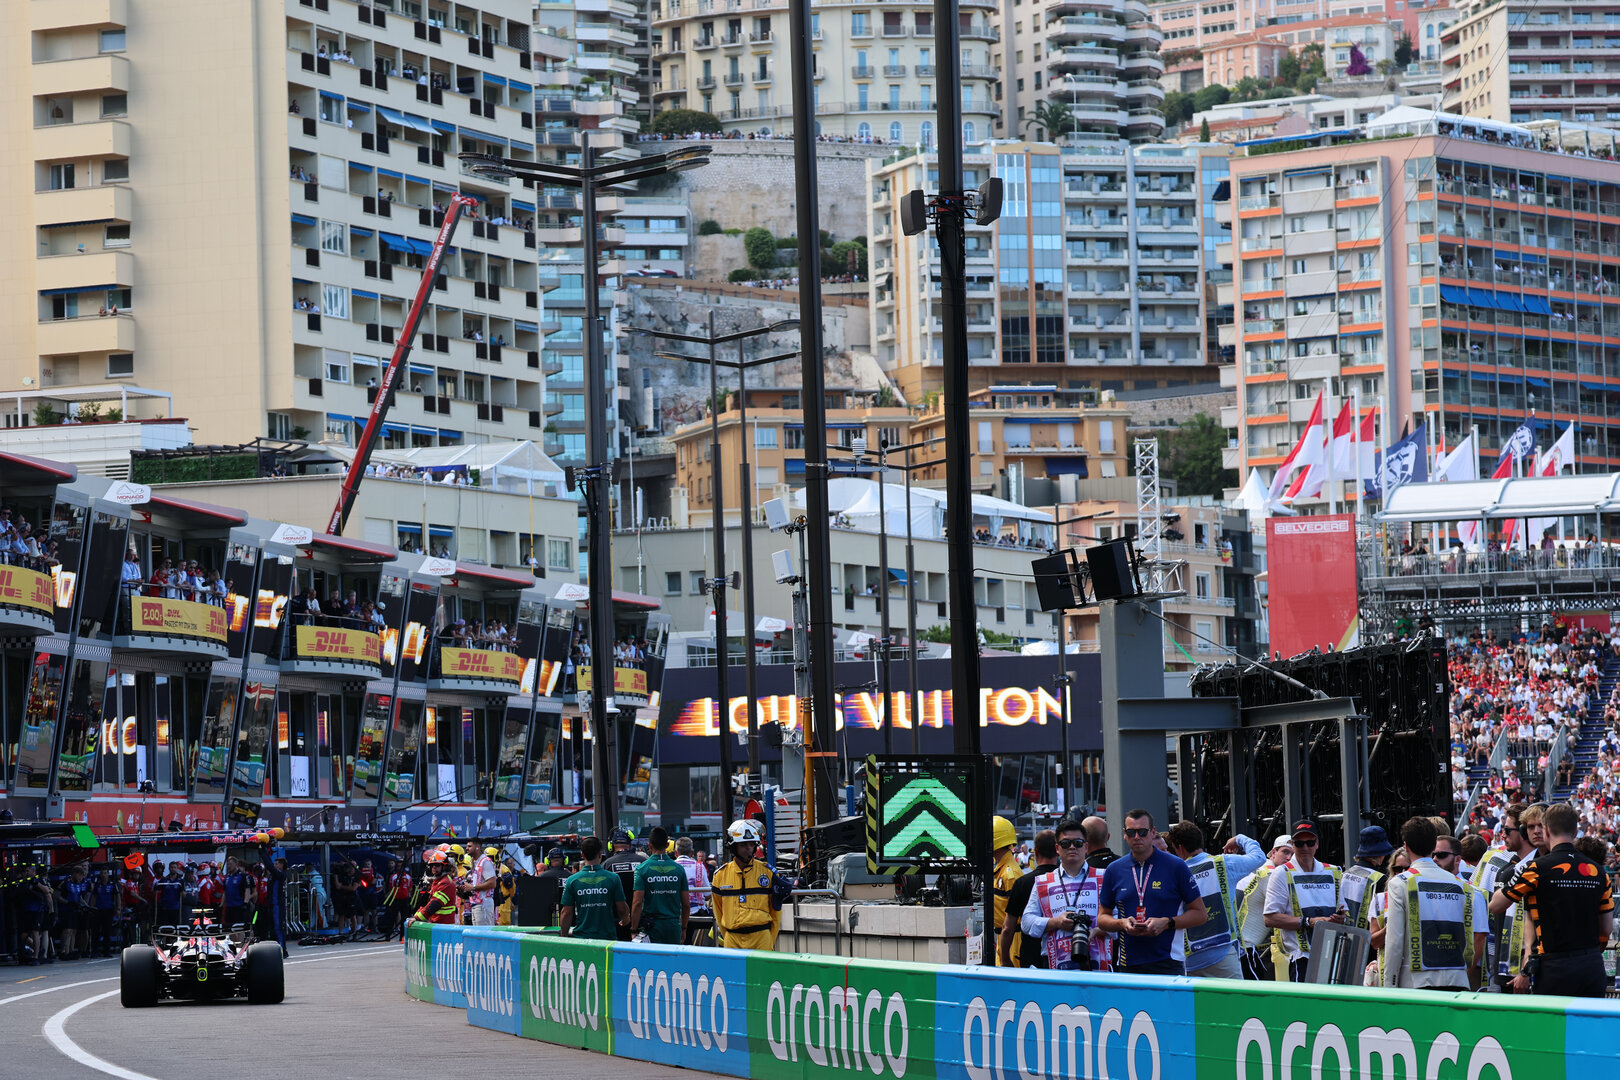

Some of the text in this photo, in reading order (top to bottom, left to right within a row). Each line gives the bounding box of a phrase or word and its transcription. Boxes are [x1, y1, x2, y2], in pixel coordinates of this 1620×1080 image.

[329, 510, 341, 533] LEVAGE
[1275, 522, 1348, 534] BELVEDERE
[314, 630, 350, 654] DHL
[457, 652, 490, 673] DHL
[860, 685, 1071, 730] VUITON
[648, 875, 679, 883] aramco
[577, 887, 609, 896] aramco
[1052, 903, 1097, 914] PHOTRAPHER
[158, 923, 245, 936] ORACLE
[1411, 936, 1420, 971] ONACO
[466, 950, 513, 1016] aramco
[529, 955, 599, 1031] aramco
[627, 967, 729, 1053] aramco
[766, 980, 909, 1078] aramco
[964, 996, 1161, 1080] aramco
